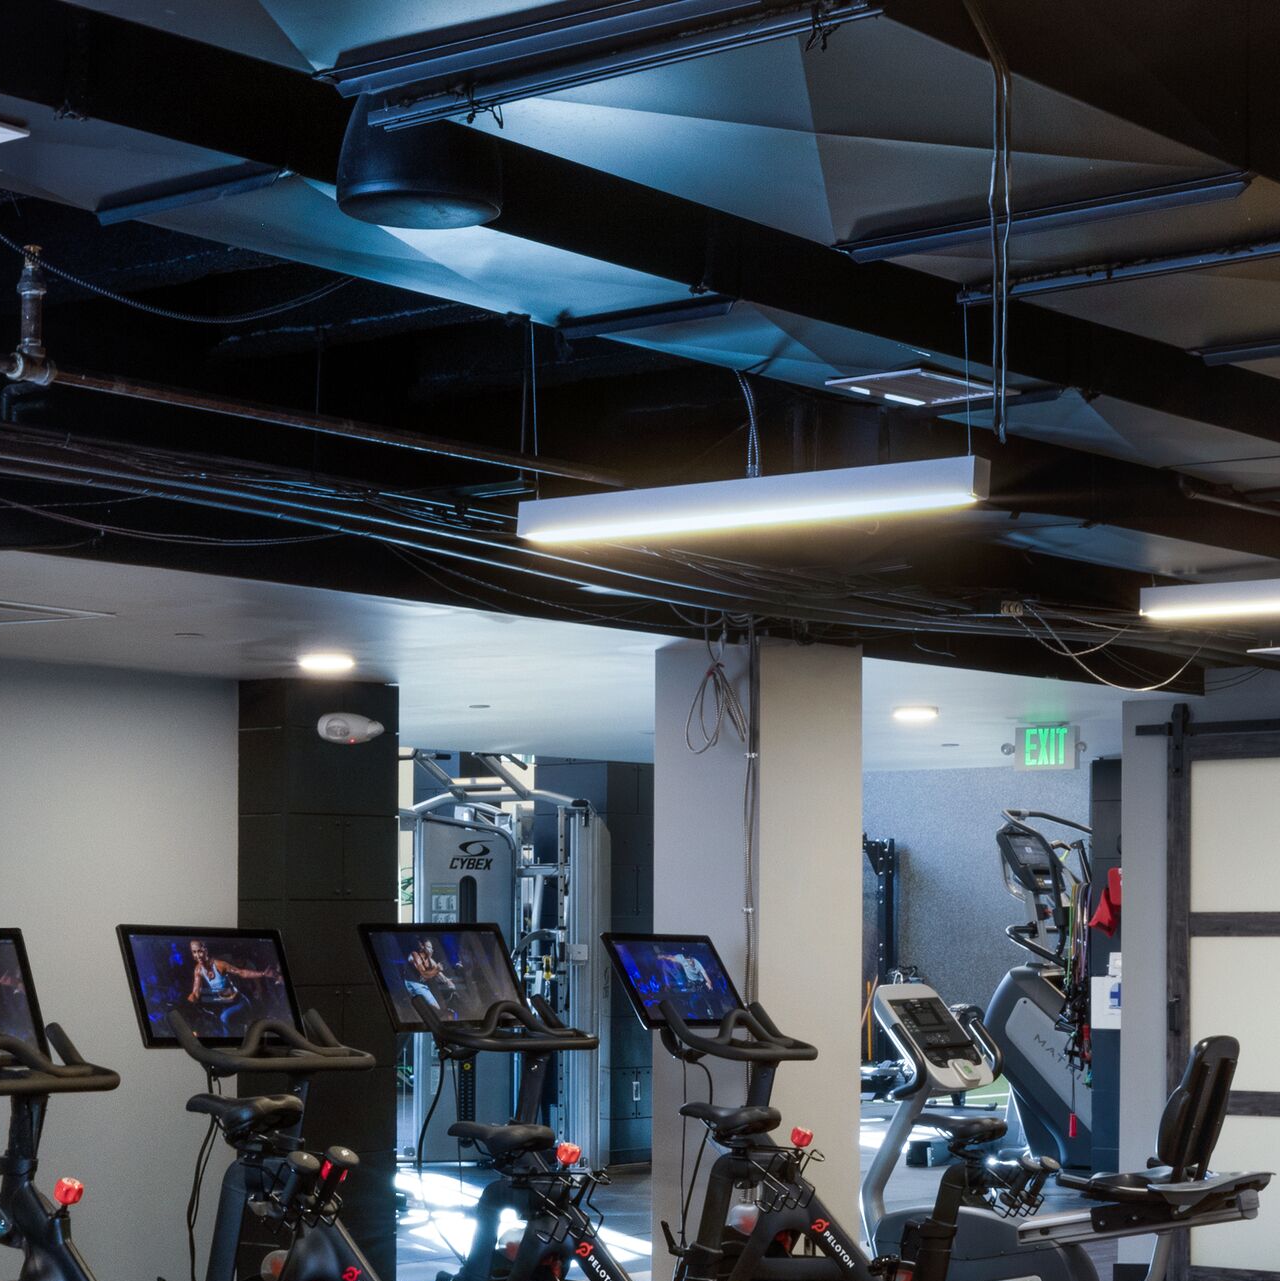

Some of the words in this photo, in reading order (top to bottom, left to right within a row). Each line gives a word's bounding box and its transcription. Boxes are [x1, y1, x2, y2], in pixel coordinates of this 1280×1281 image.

[1025, 728, 1067, 765] EXIT
[449, 857, 493, 870] CYBEX
[823, 1230, 855, 1269] PELOTON
